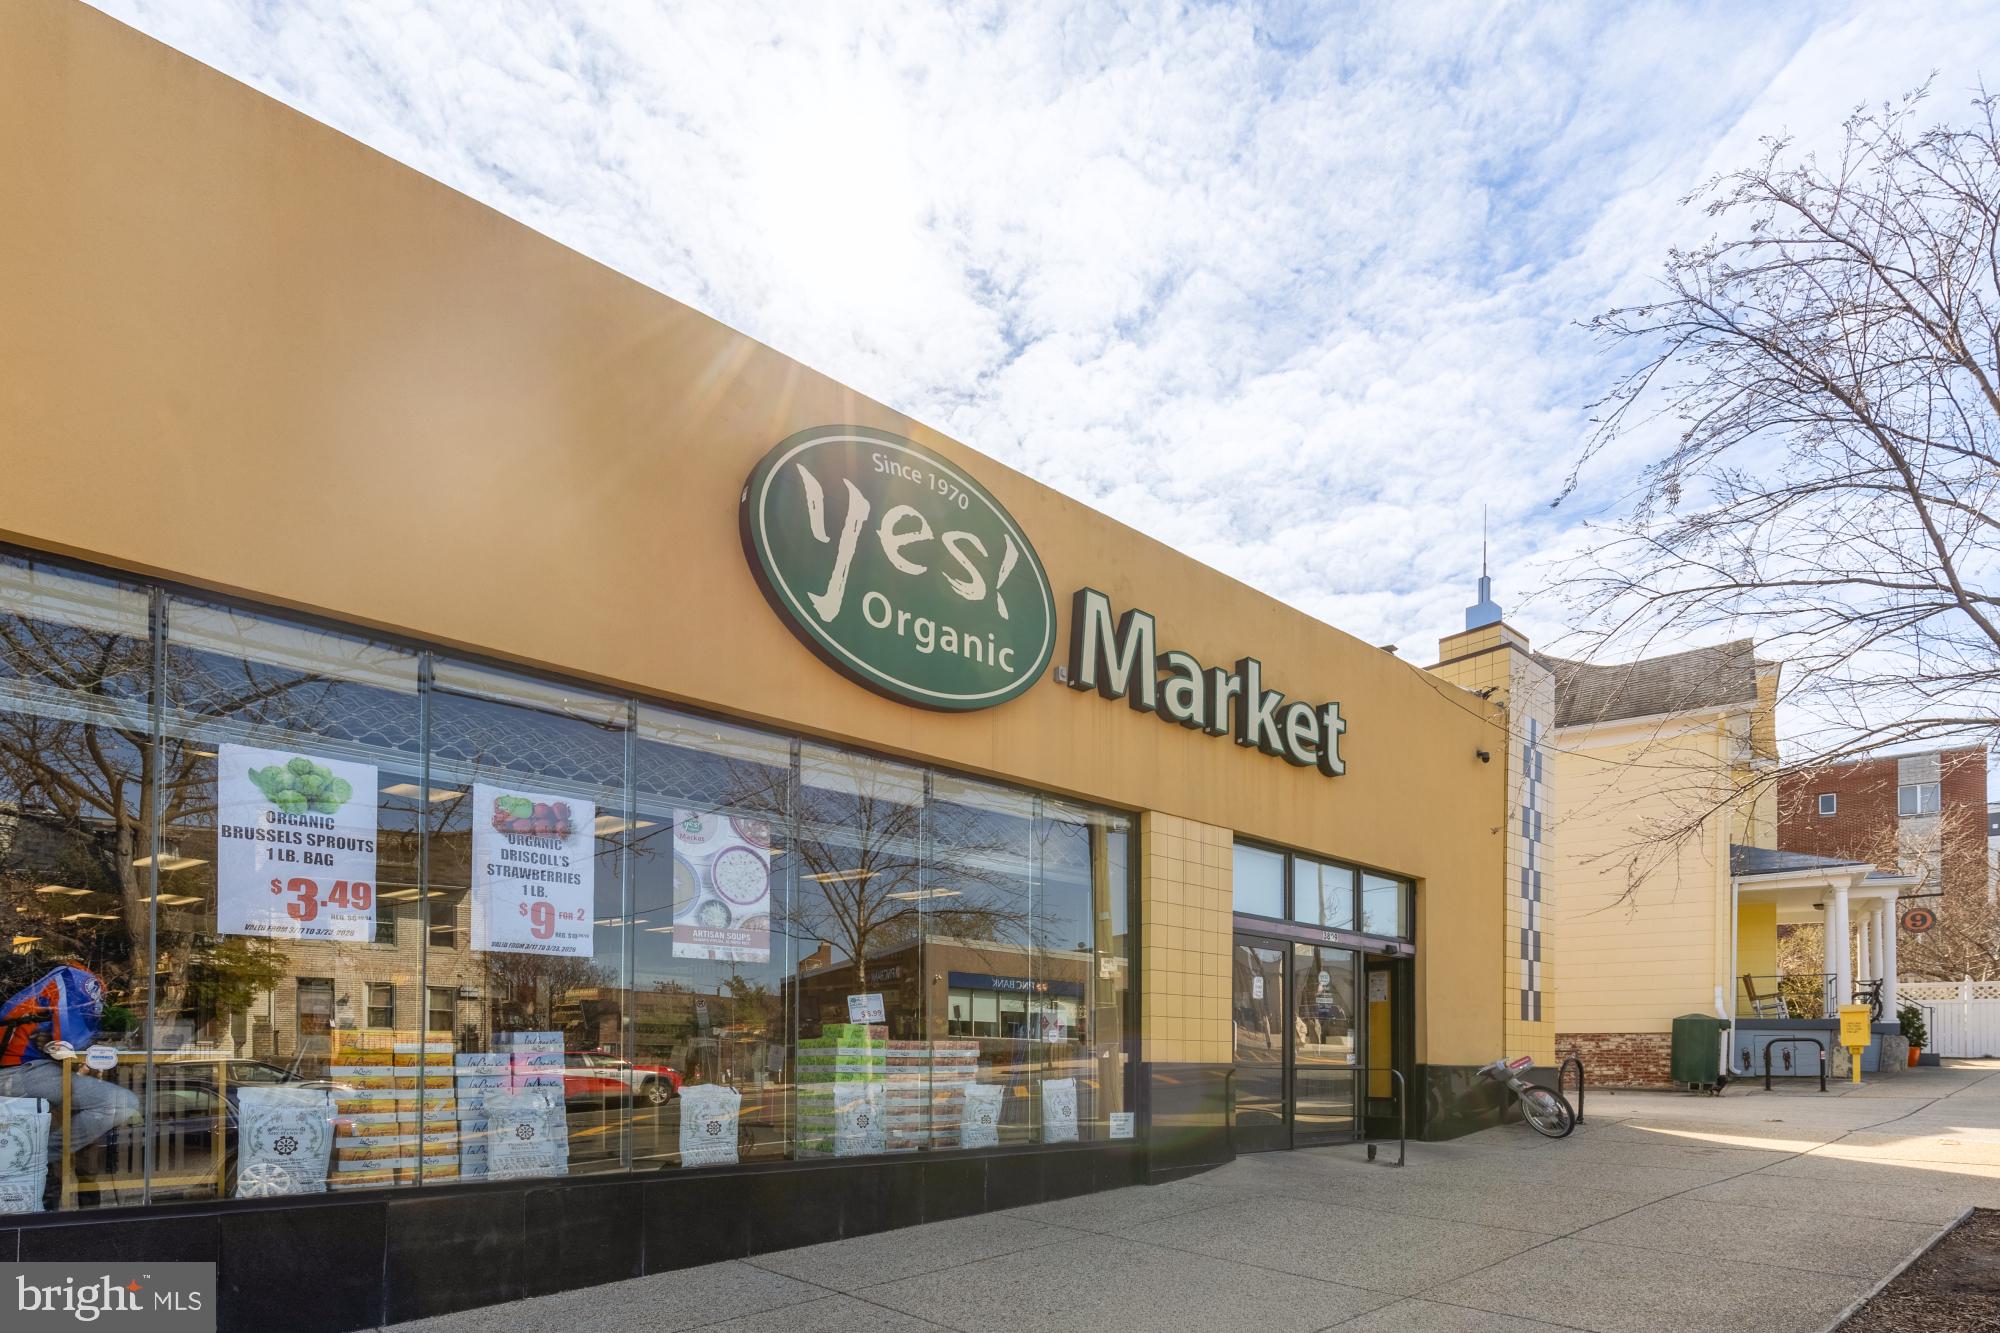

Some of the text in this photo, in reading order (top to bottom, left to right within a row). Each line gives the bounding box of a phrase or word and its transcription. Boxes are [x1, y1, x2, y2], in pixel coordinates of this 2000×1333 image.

[872, 452, 969, 510] Since 1970
[862, 591, 1015, 673] Organic
[1068, 587, 1347, 777] Market
[266, 811, 335, 830] ORGANIC
[221, 825, 374, 853] BRUSSELS SPROUTS
[507, 833, 562, 851] ORGANIC
[266, 848, 334, 866] 1 LB. BAG
[501, 848, 570, 867] DRISCOLL'S
[487, 863, 581, 885] STRAWBERRIES
[270, 877, 372, 922] $3.49
[522, 884, 548, 898] 1 LB.
[559, 911, 573, 921] FOR
[576, 908, 585, 922] 2
[289, 926, 305, 935] 3/7
[692, 929, 725, 940] ARTISAN
[726, 932, 751, 942] SOUPS
